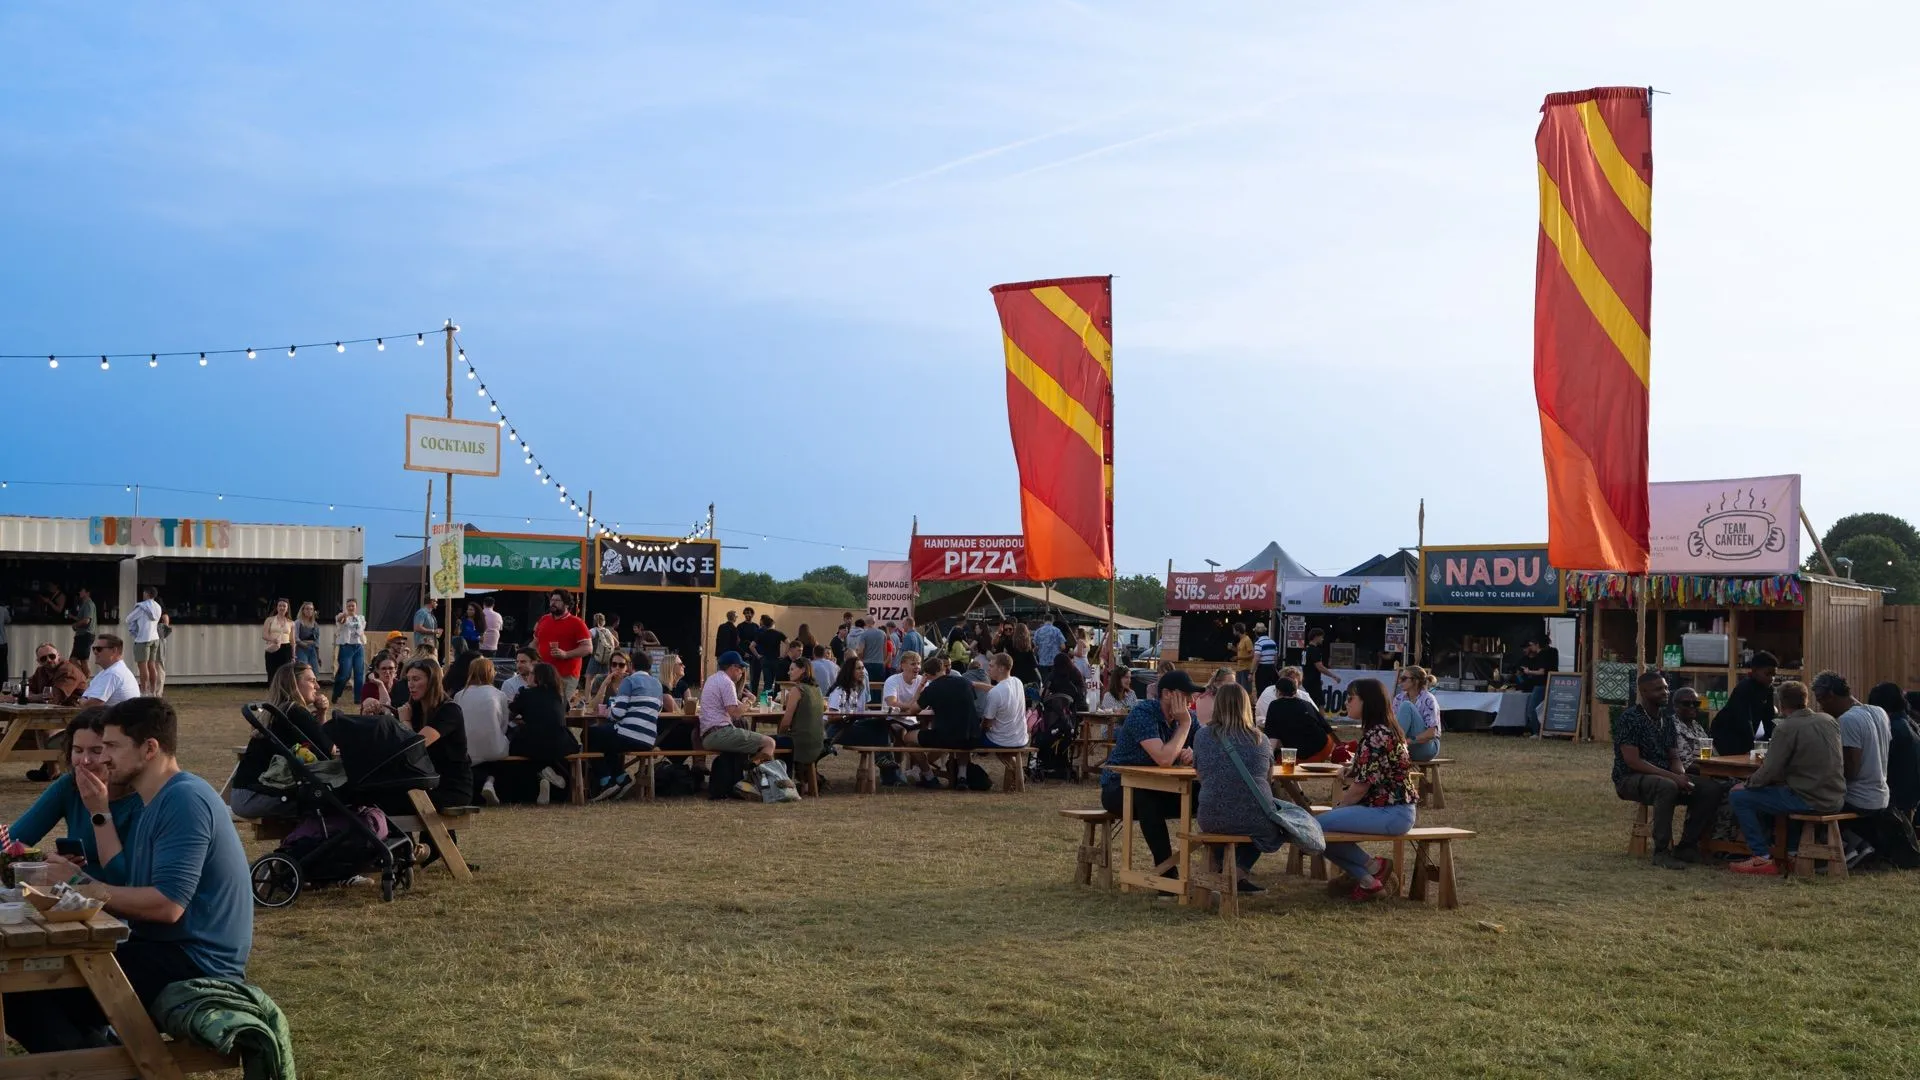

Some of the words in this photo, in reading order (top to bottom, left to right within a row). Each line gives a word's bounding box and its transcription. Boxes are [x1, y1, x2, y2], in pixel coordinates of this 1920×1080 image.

[420, 436, 486, 455] COCKTAILS
[89, 515, 231, 549] COCKTAILS
[1722, 523, 1747, 534] TEAM
[924, 539, 977, 549] HANDMADE
[979, 539, 1025, 549] SOURDOU
[1715, 534, 1754, 546] CANTEEN
[529, 556, 582, 570] TAPAS
[626, 555, 696, 573] WANGS
[944, 551, 1018, 574] PIZZA
[1445, 556, 1540, 586] NADU
[869, 581, 909, 589] HANDMADE
[1175, 584, 1207, 600] SUBS
[1224, 583, 1267, 600] SPUDS
[867, 593, 912, 601] SOURDOUGH
[869, 607, 909, 620] PIZZA
